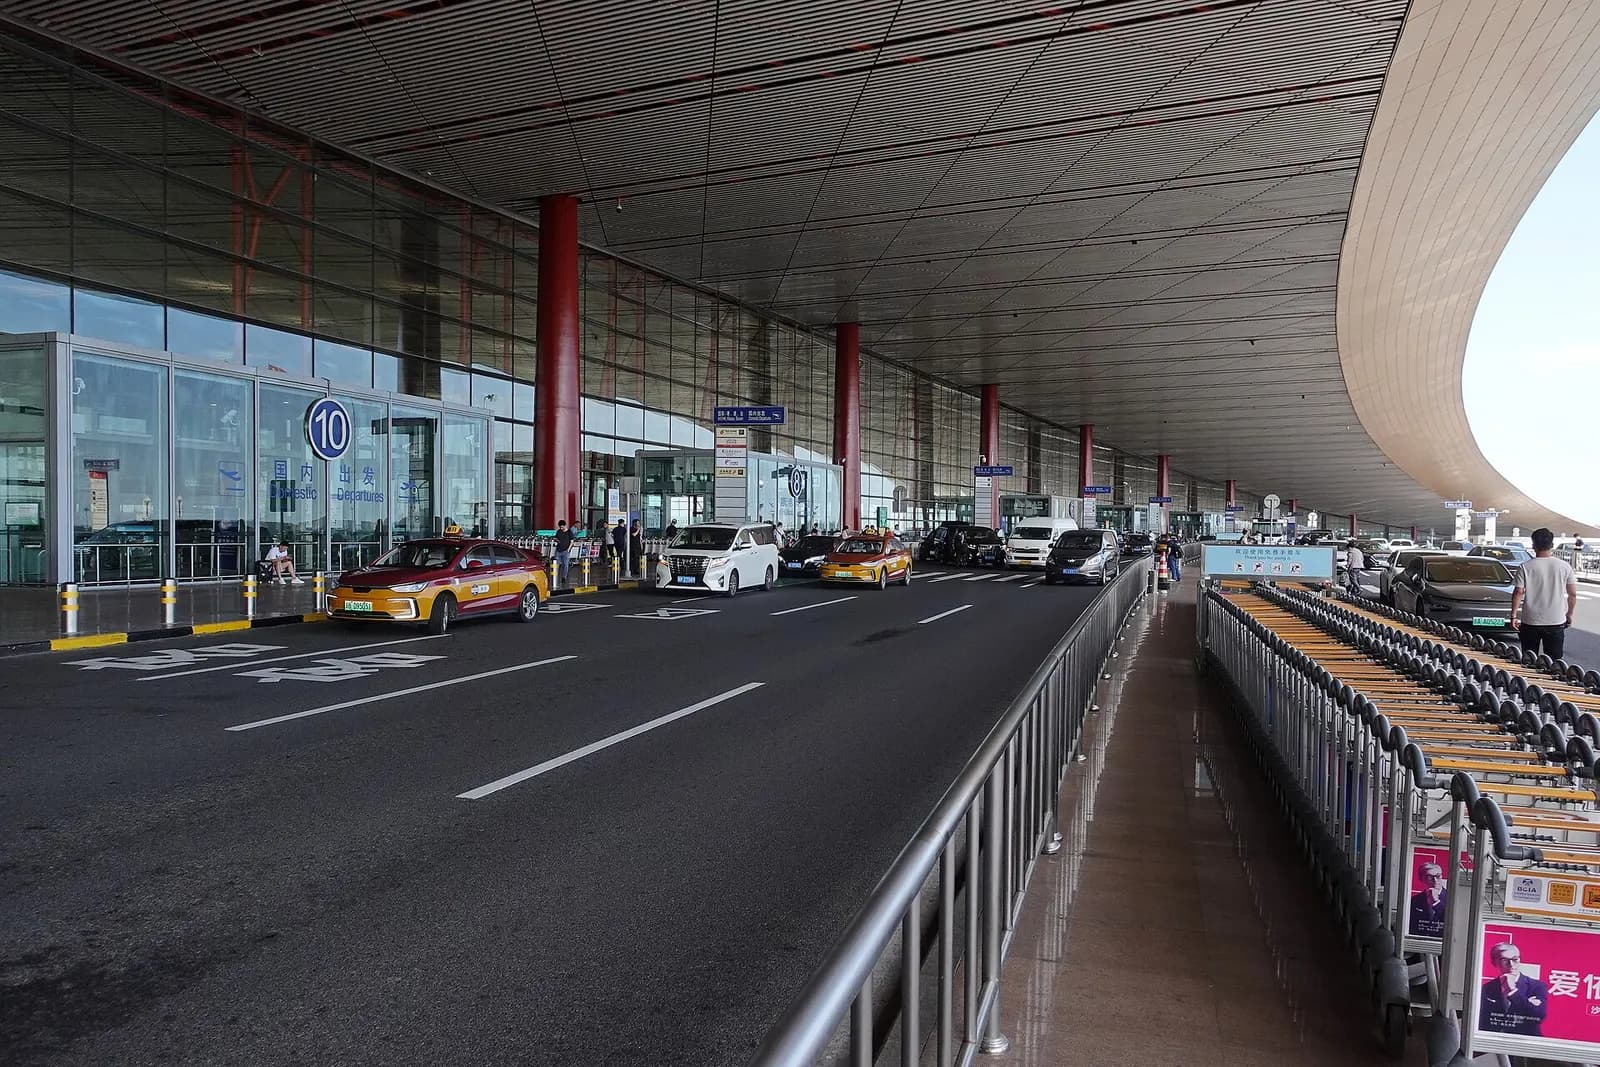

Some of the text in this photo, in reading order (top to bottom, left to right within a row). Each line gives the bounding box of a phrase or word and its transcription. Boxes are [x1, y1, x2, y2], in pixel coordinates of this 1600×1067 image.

[315, 408, 347, 450] 10
[270, 480, 385, 504] Domestic Departures
[794, 471, 800, 493] 8
